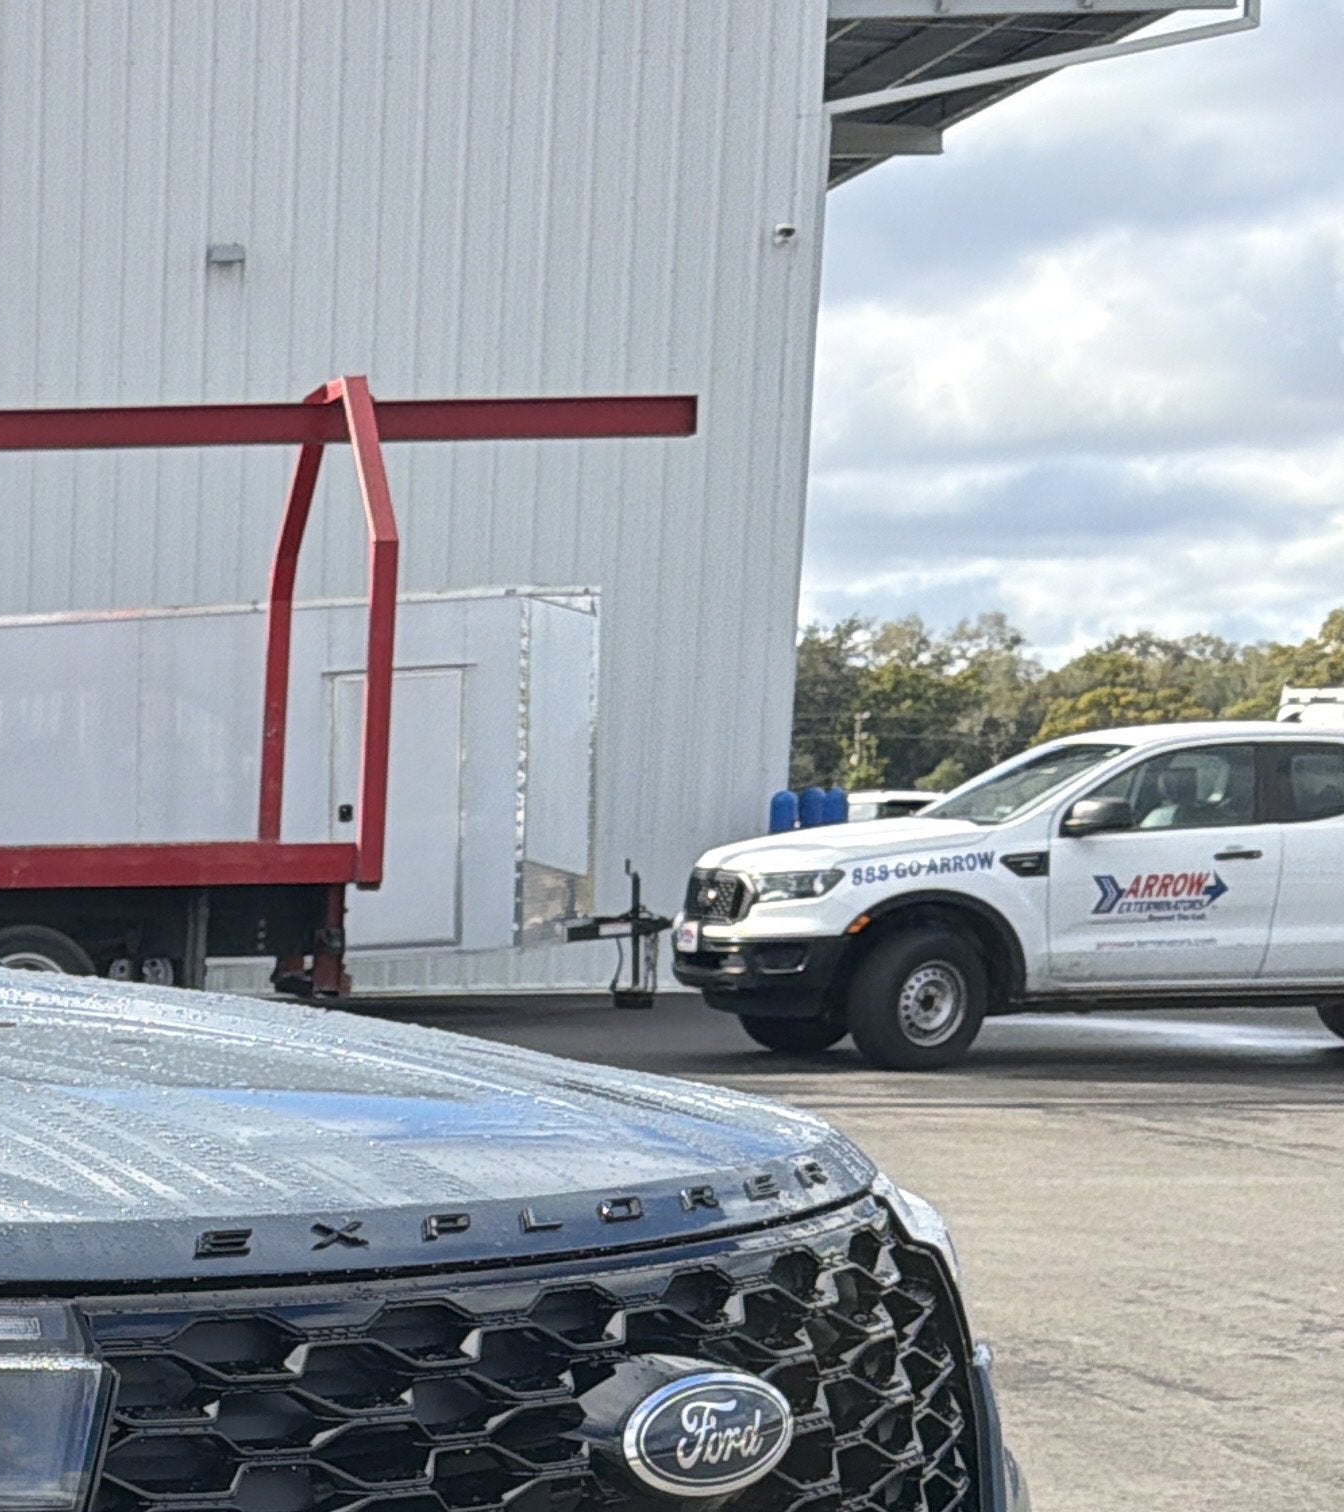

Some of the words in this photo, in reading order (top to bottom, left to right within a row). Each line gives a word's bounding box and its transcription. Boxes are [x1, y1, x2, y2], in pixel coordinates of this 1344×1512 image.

[1125, 872, 1210, 898] ARROW
[194, 1158, 828, 1260] EXPLORER
[677, 1399, 763, 1470] Ford
